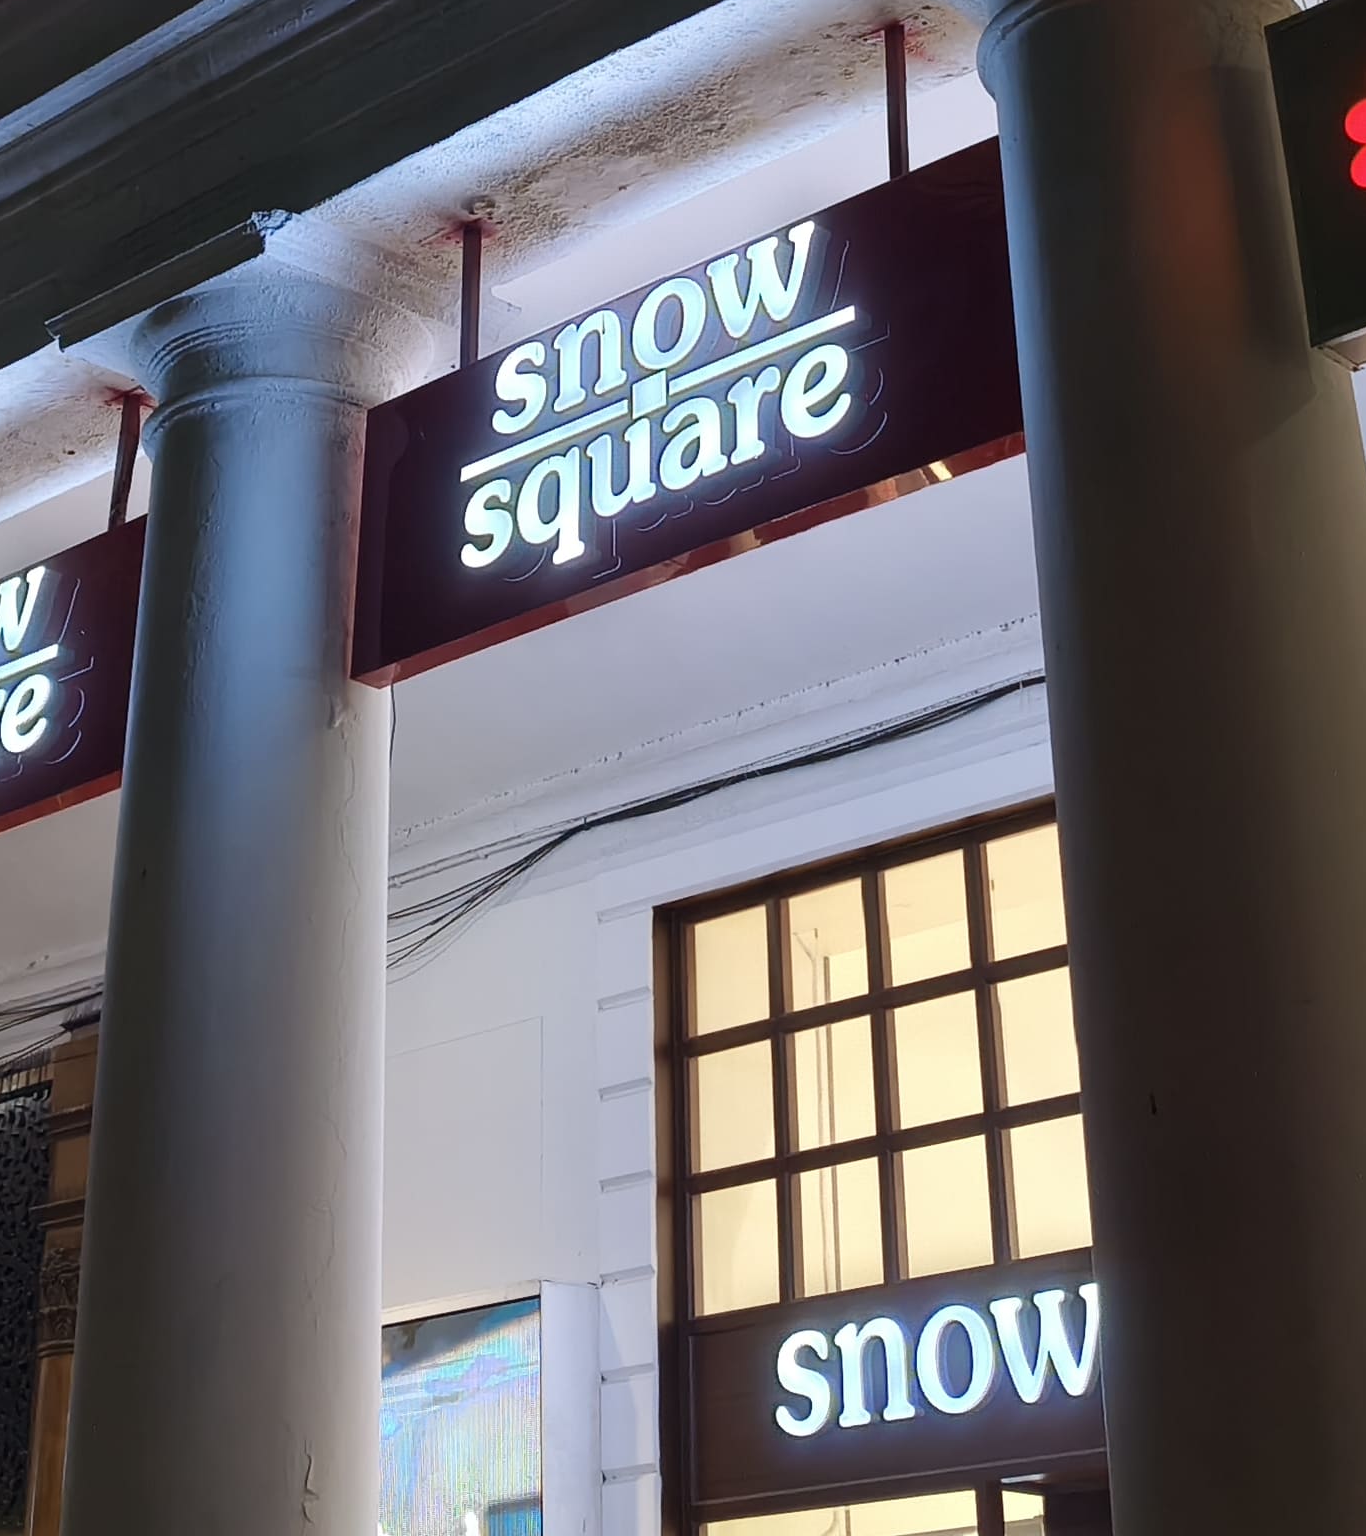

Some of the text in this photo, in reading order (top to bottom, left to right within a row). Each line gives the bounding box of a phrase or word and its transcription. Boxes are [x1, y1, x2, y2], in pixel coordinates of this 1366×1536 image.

[492, 220, 816, 435] snow
[460, 344, 852, 568] square
[775, 1282, 1101, 1437] snow
